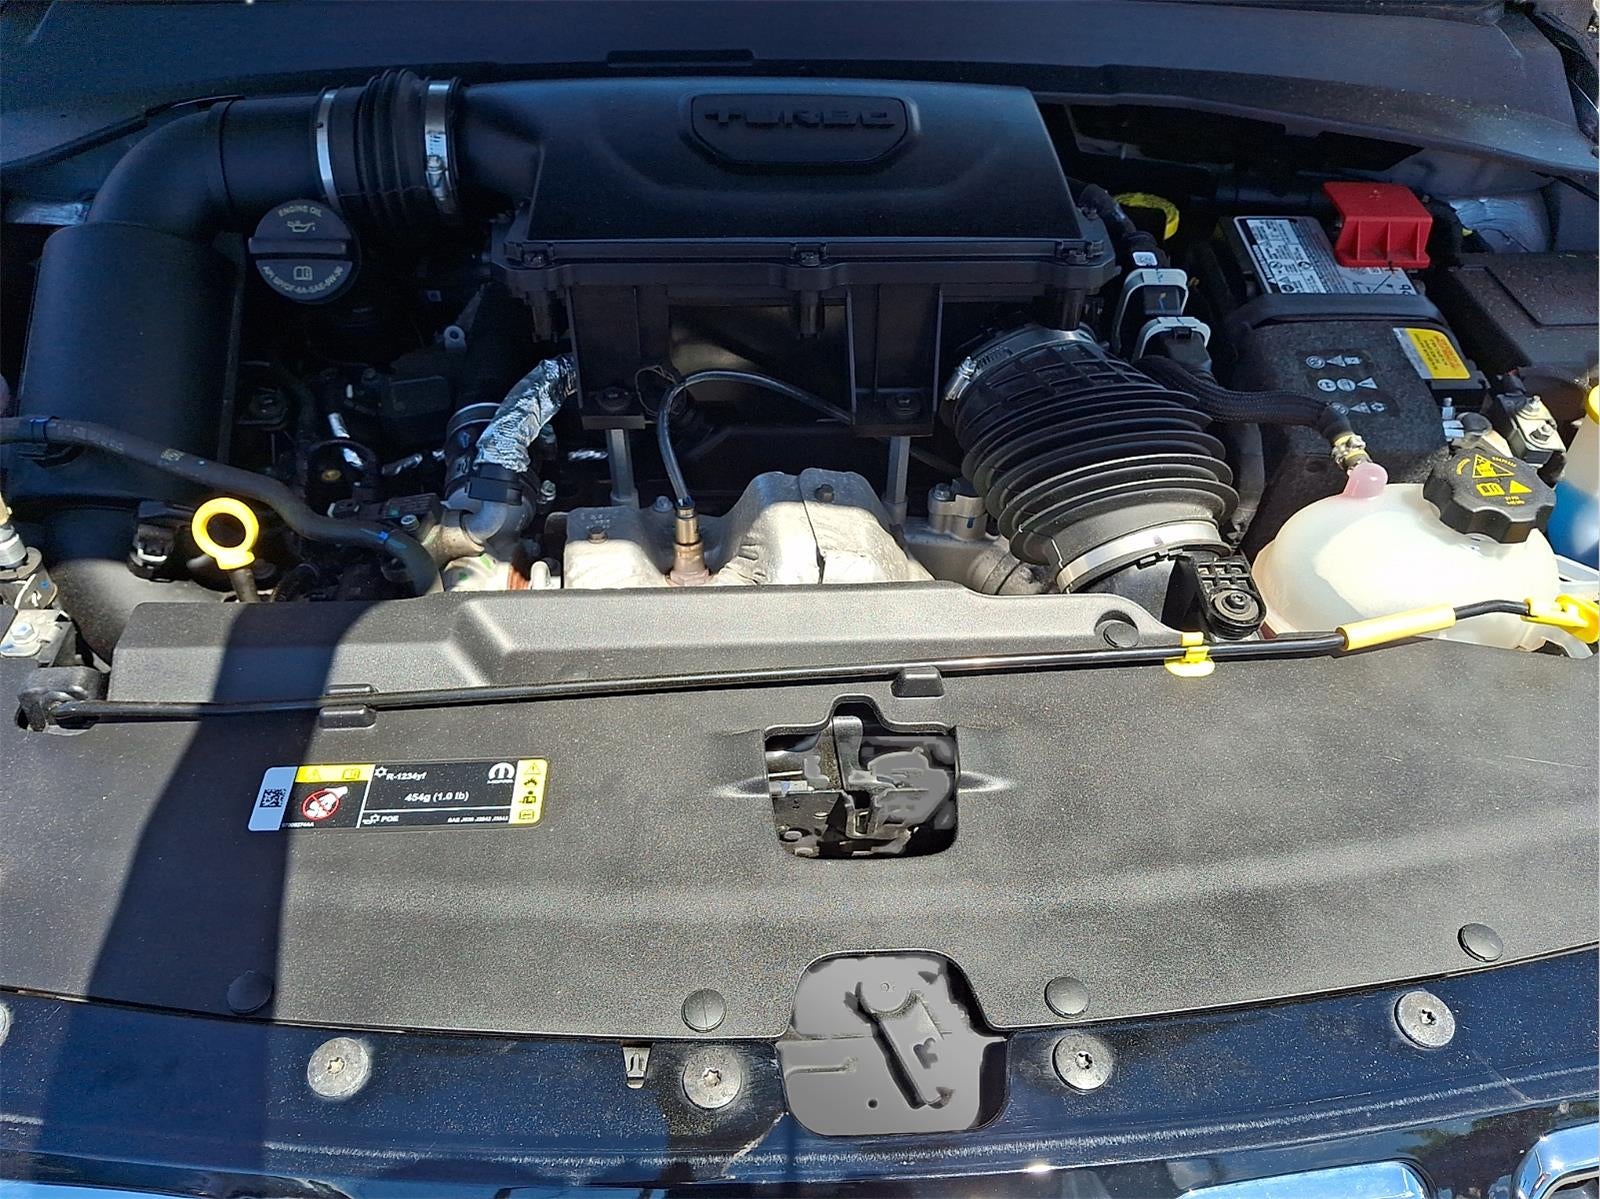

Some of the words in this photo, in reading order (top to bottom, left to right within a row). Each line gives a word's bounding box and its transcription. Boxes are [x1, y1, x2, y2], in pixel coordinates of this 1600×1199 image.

[385, 771, 427, 781] R-1234yf
[404, 792, 432, 803] 454g
[432, 791, 454, 803] (1.0
[454, 791, 470, 802] lb)
[380, 815, 399, 823] POE
